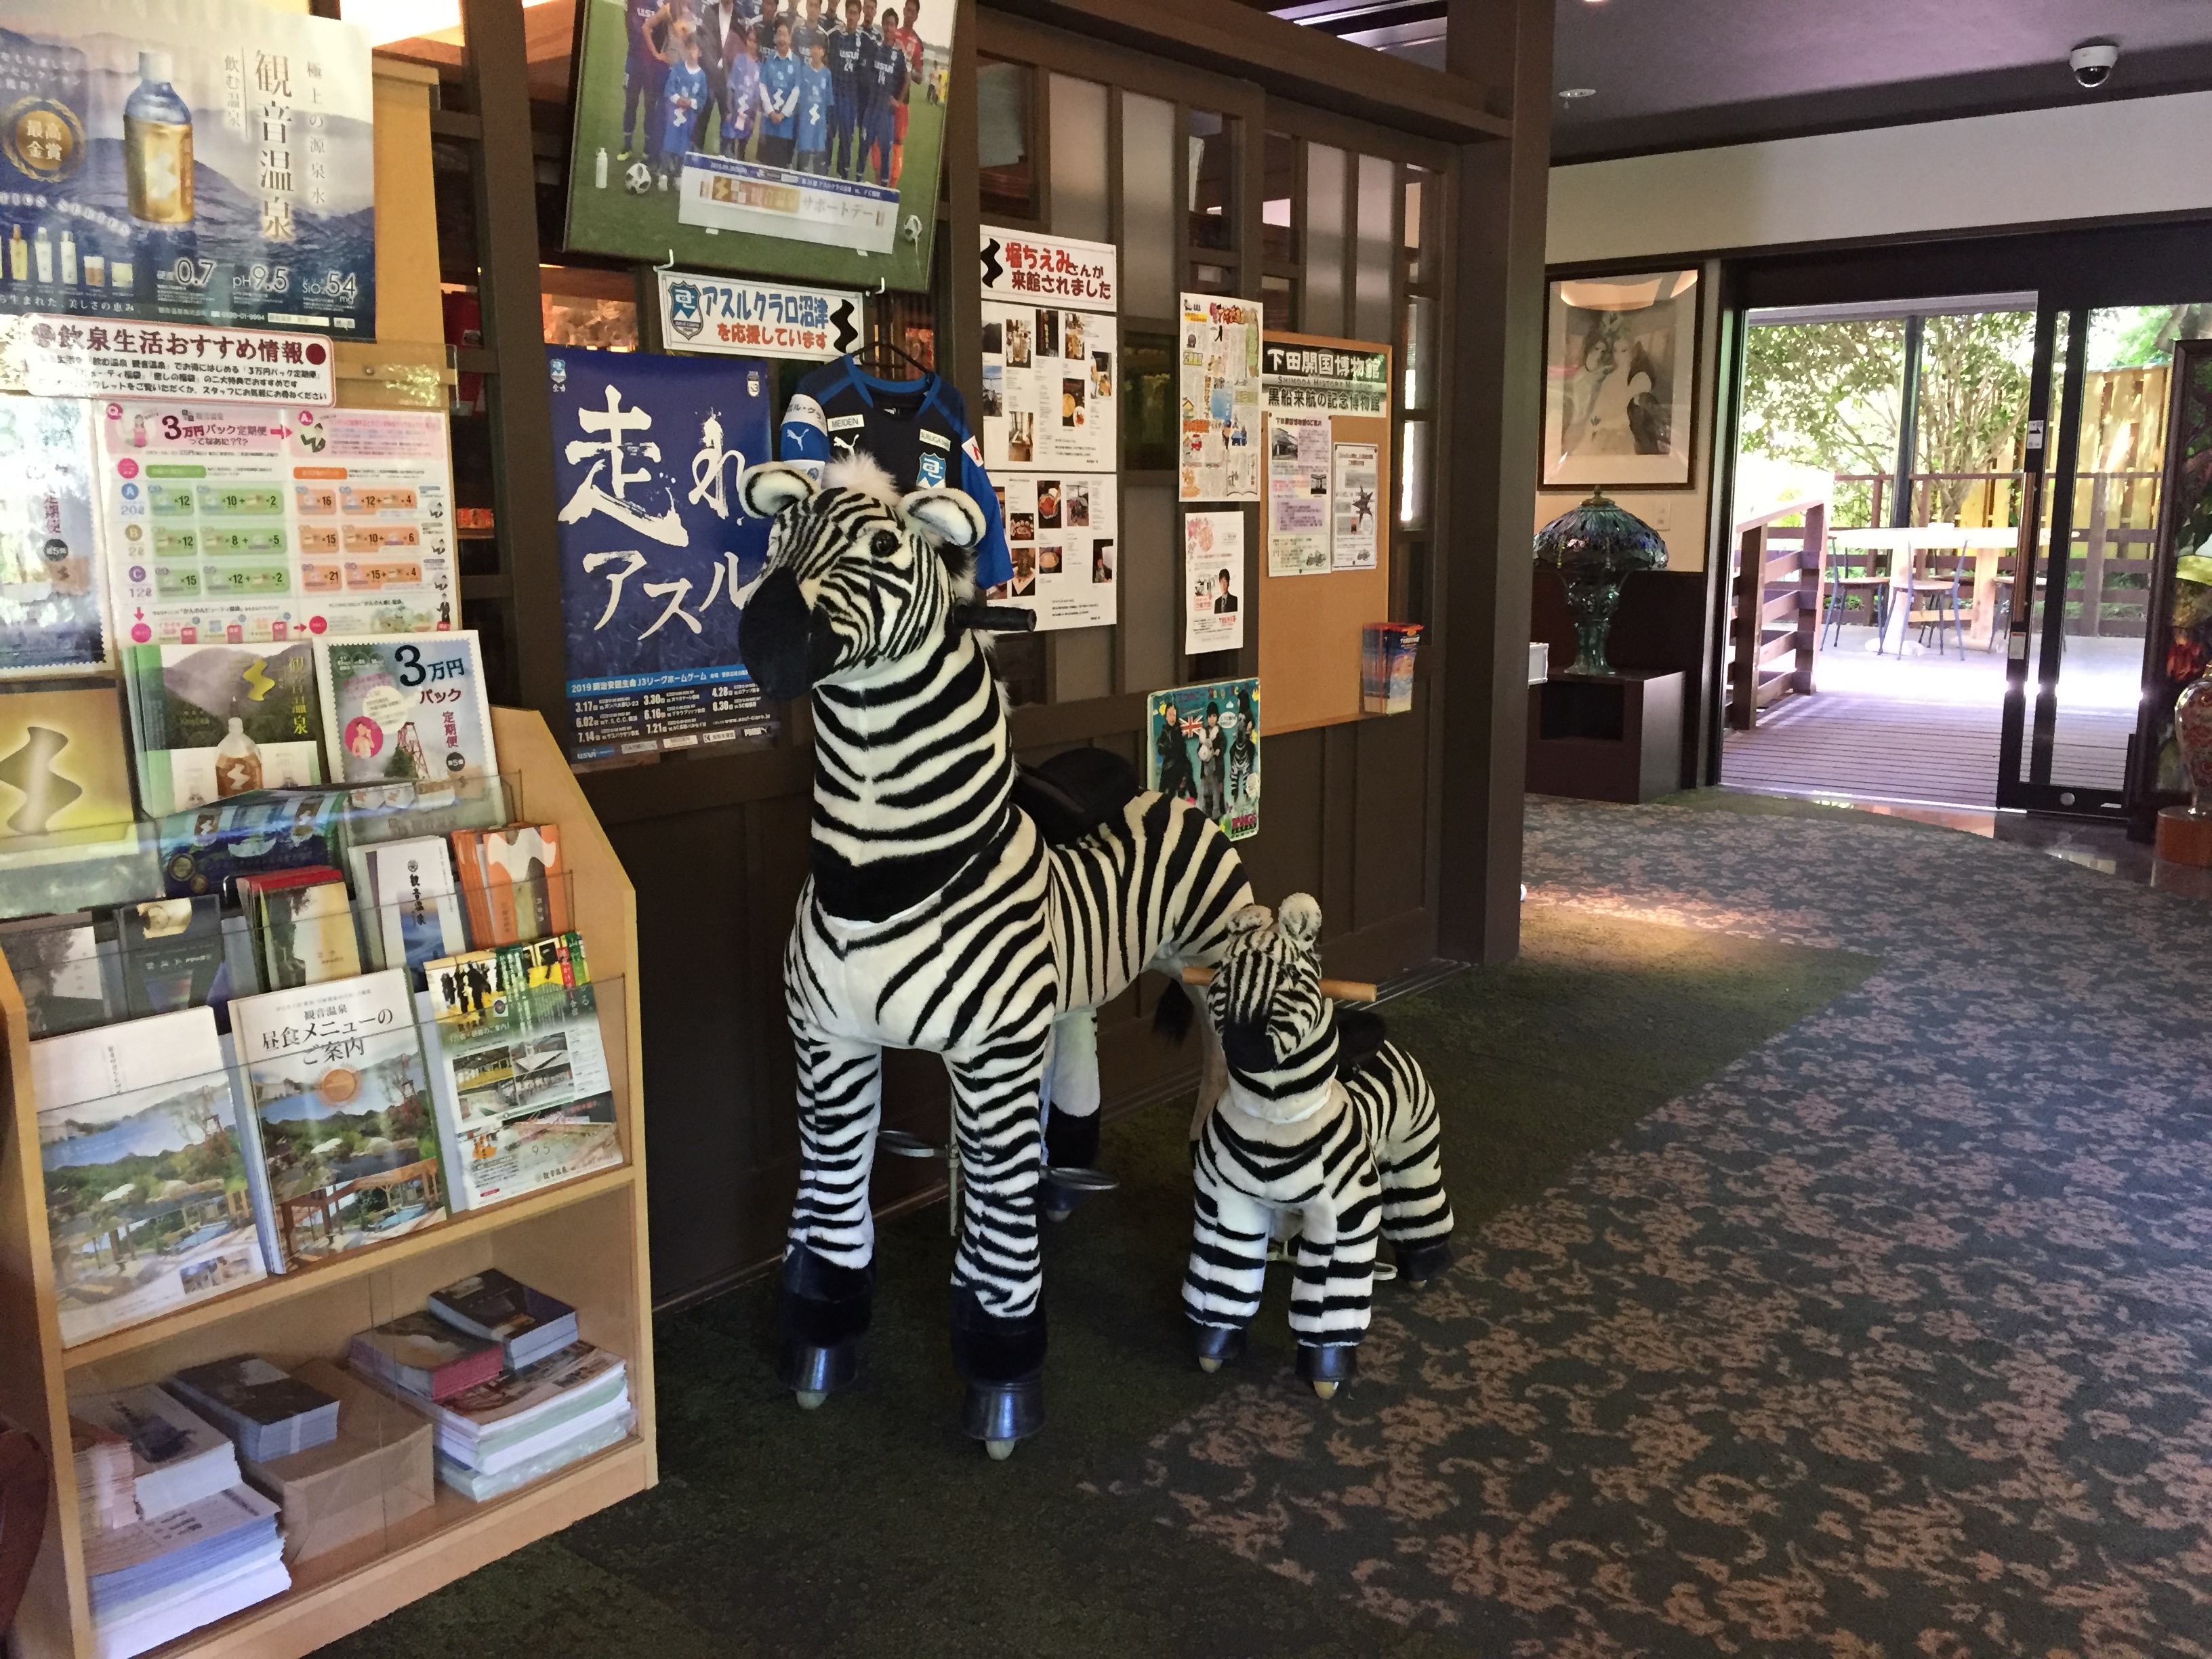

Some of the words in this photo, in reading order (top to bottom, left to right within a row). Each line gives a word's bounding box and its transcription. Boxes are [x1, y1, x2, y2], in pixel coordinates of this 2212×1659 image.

[224, 55, 241, 127] 飲む温泉
[255, 49, 294, 239] 観音温泉
[307, 61, 326, 204] 極上の源泉水
[26, 140, 62, 161] 金賞
[802, 195, 873, 219] サポートデー
[177, 259, 217, 285] 0.7
[1005, 241, 1105, 280] 堀ちえみさんが
[232, 275, 251, 289] pH
[251, 265, 287, 291] 9.5
[326, 271, 356, 296] 54
[1011, 269, 1111, 300] 来館されました
[340, 294, 354, 305] mg
[702, 285, 829, 329] アスルクラロ沼津
[716, 322, 827, 350] を応援しています
[1267, 348, 1380, 380] 下田開国博物館
[1268, 386, 1380, 413] 黒船来航の記念博物館
[832, 418, 859, 428] MEIDEN
[557, 384, 747, 548] 走れ
[582, 550, 761, 640] アスル
[394, 644, 465, 687] 3万円
[419, 688, 462, 705] パック
[571, 684, 592, 693] 2019
[442, 710, 459, 749] 定期便
[304, 1003, 348, 1021] 観音温泉
[262, 1008, 394, 1050] 昼食メニューの
[303, 1036, 365, 1065] ご案内
